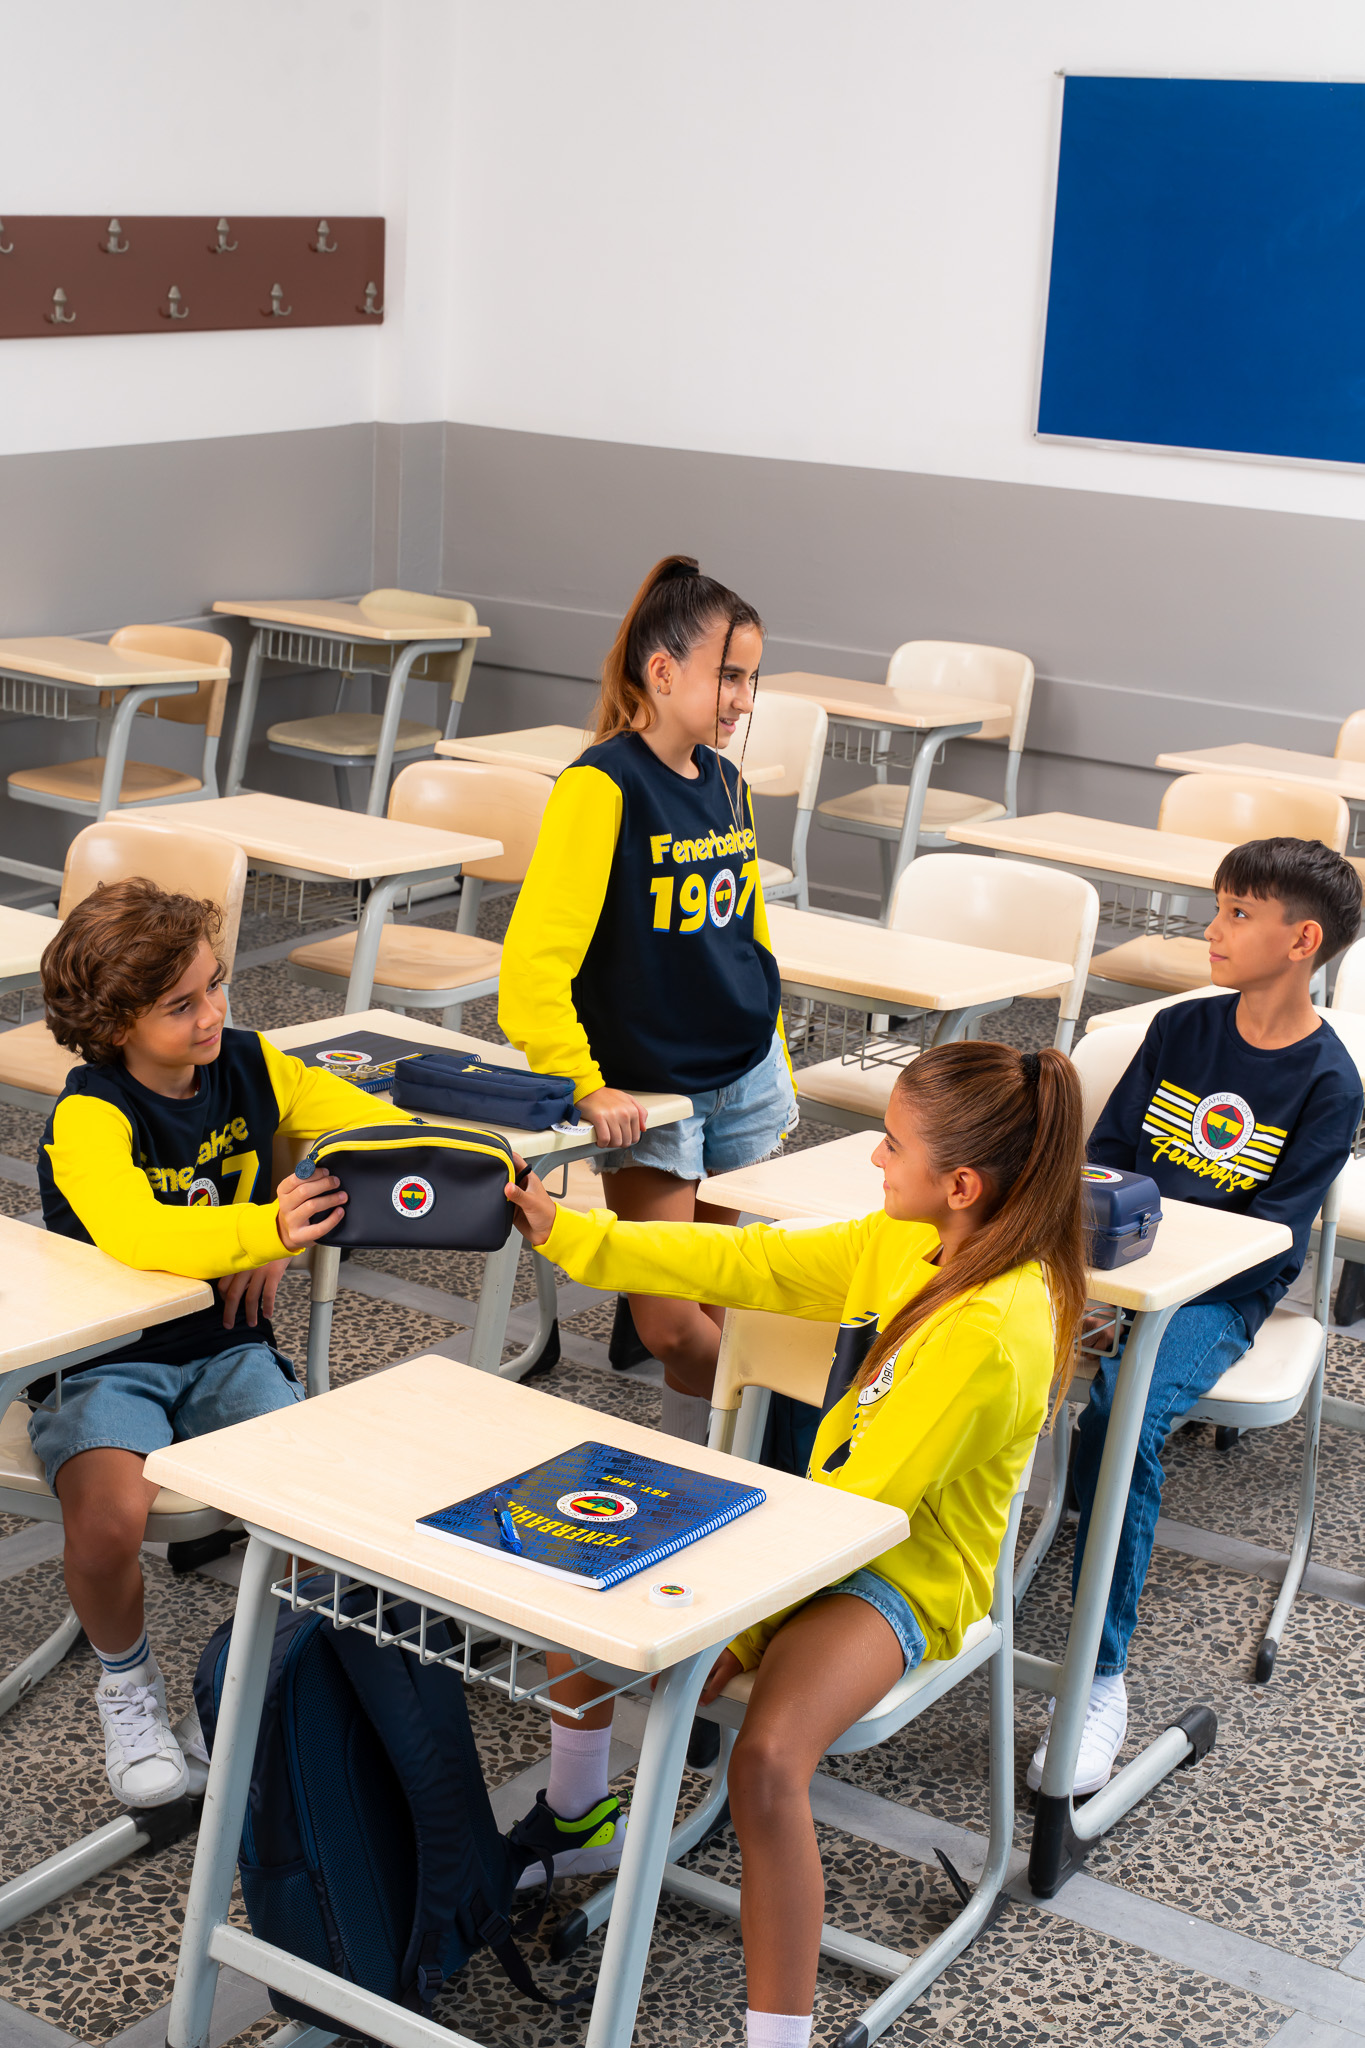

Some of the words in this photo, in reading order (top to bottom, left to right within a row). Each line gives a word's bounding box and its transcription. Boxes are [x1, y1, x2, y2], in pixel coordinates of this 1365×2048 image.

[650, 824, 755, 864] Fenerbahçe
[1194, 1094, 1232, 1136] FENERBAHÇE
[1233, 1097, 1251, 1119] SPOR
[601, 1475, 637, 1488] 1907
[640, 1485, 671, 1498] EST.
